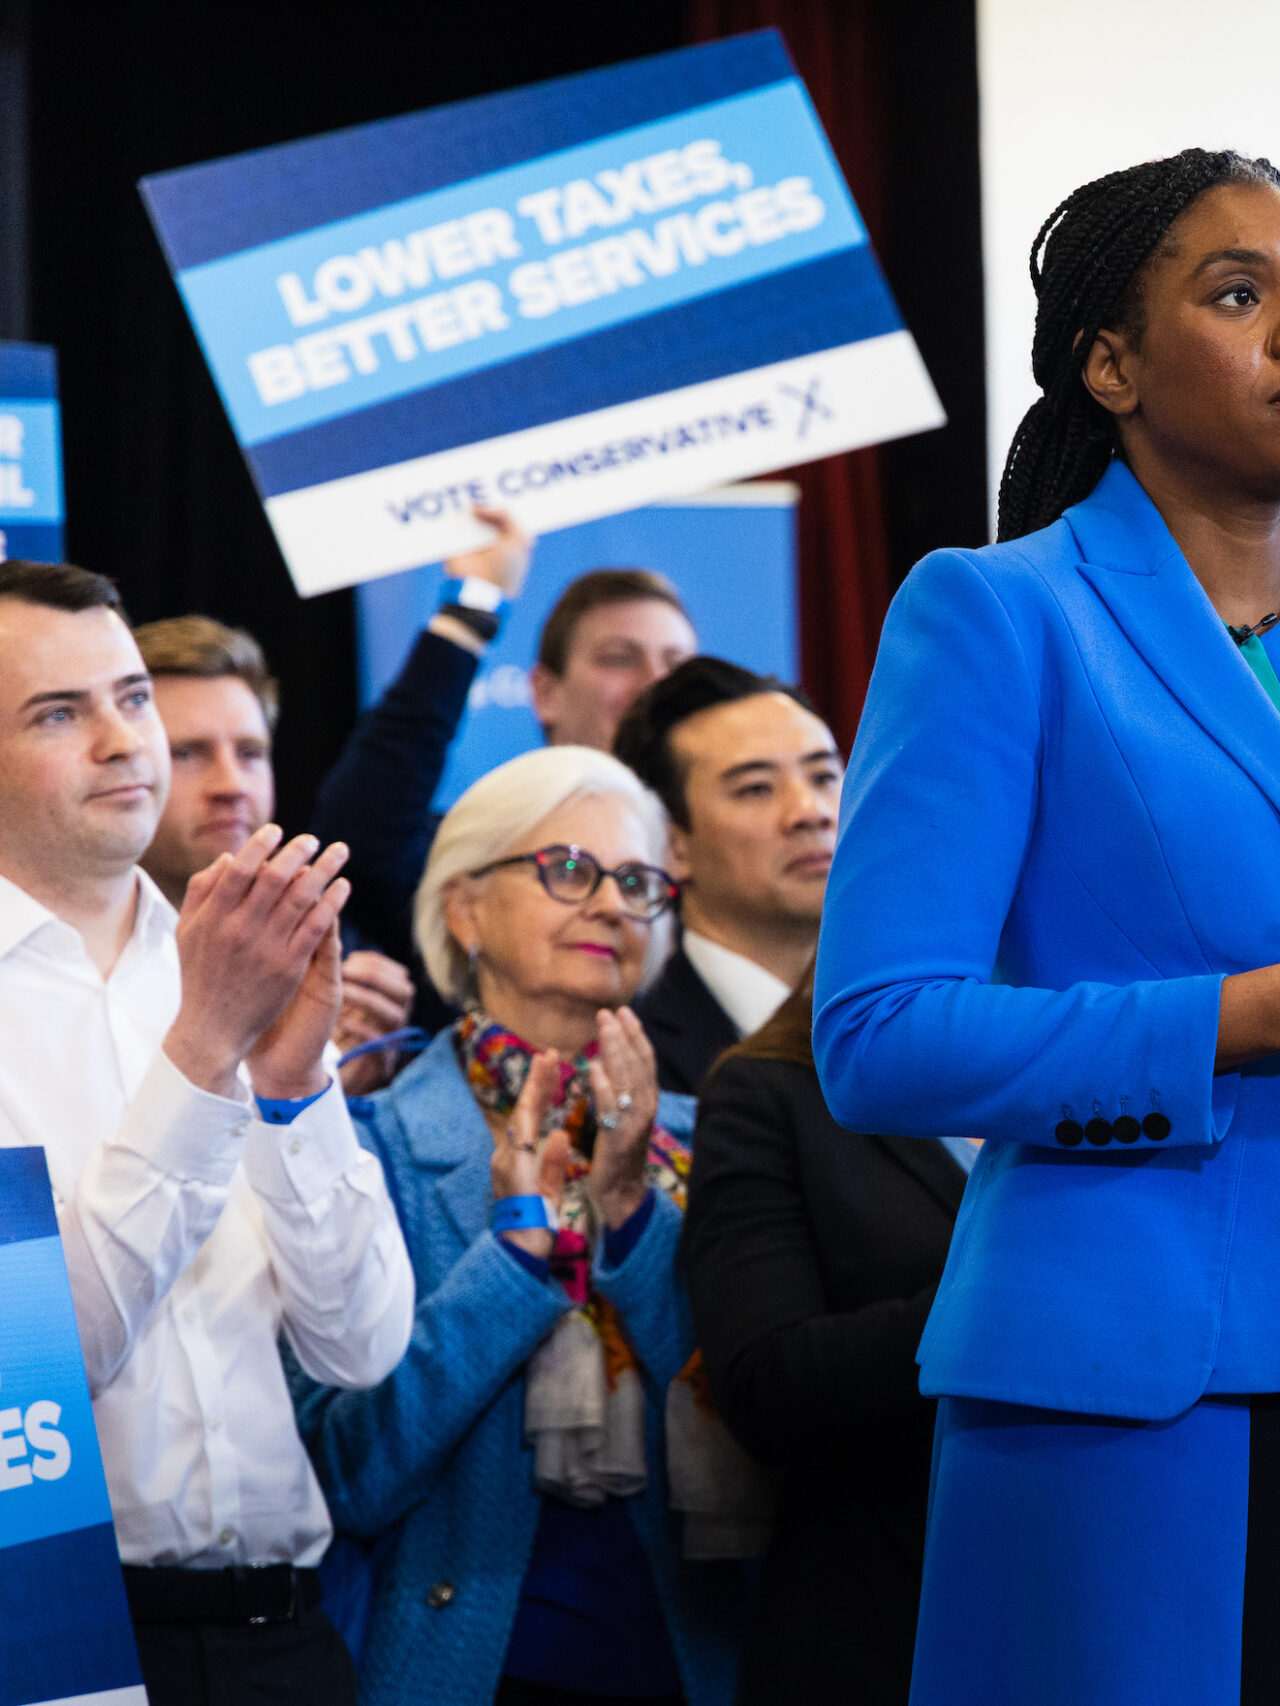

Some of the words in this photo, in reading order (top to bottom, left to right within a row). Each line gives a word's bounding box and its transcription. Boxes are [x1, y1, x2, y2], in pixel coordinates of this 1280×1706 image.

[249, 281, 508, 406] BETTER
[510, 177, 824, 318] SERVICES
[278, 209, 520, 326] LOWER
[519, 140, 752, 243] TAXES,
[385, 481, 487, 524] VOTE
[497, 402, 774, 496] CONSERVATIVE
